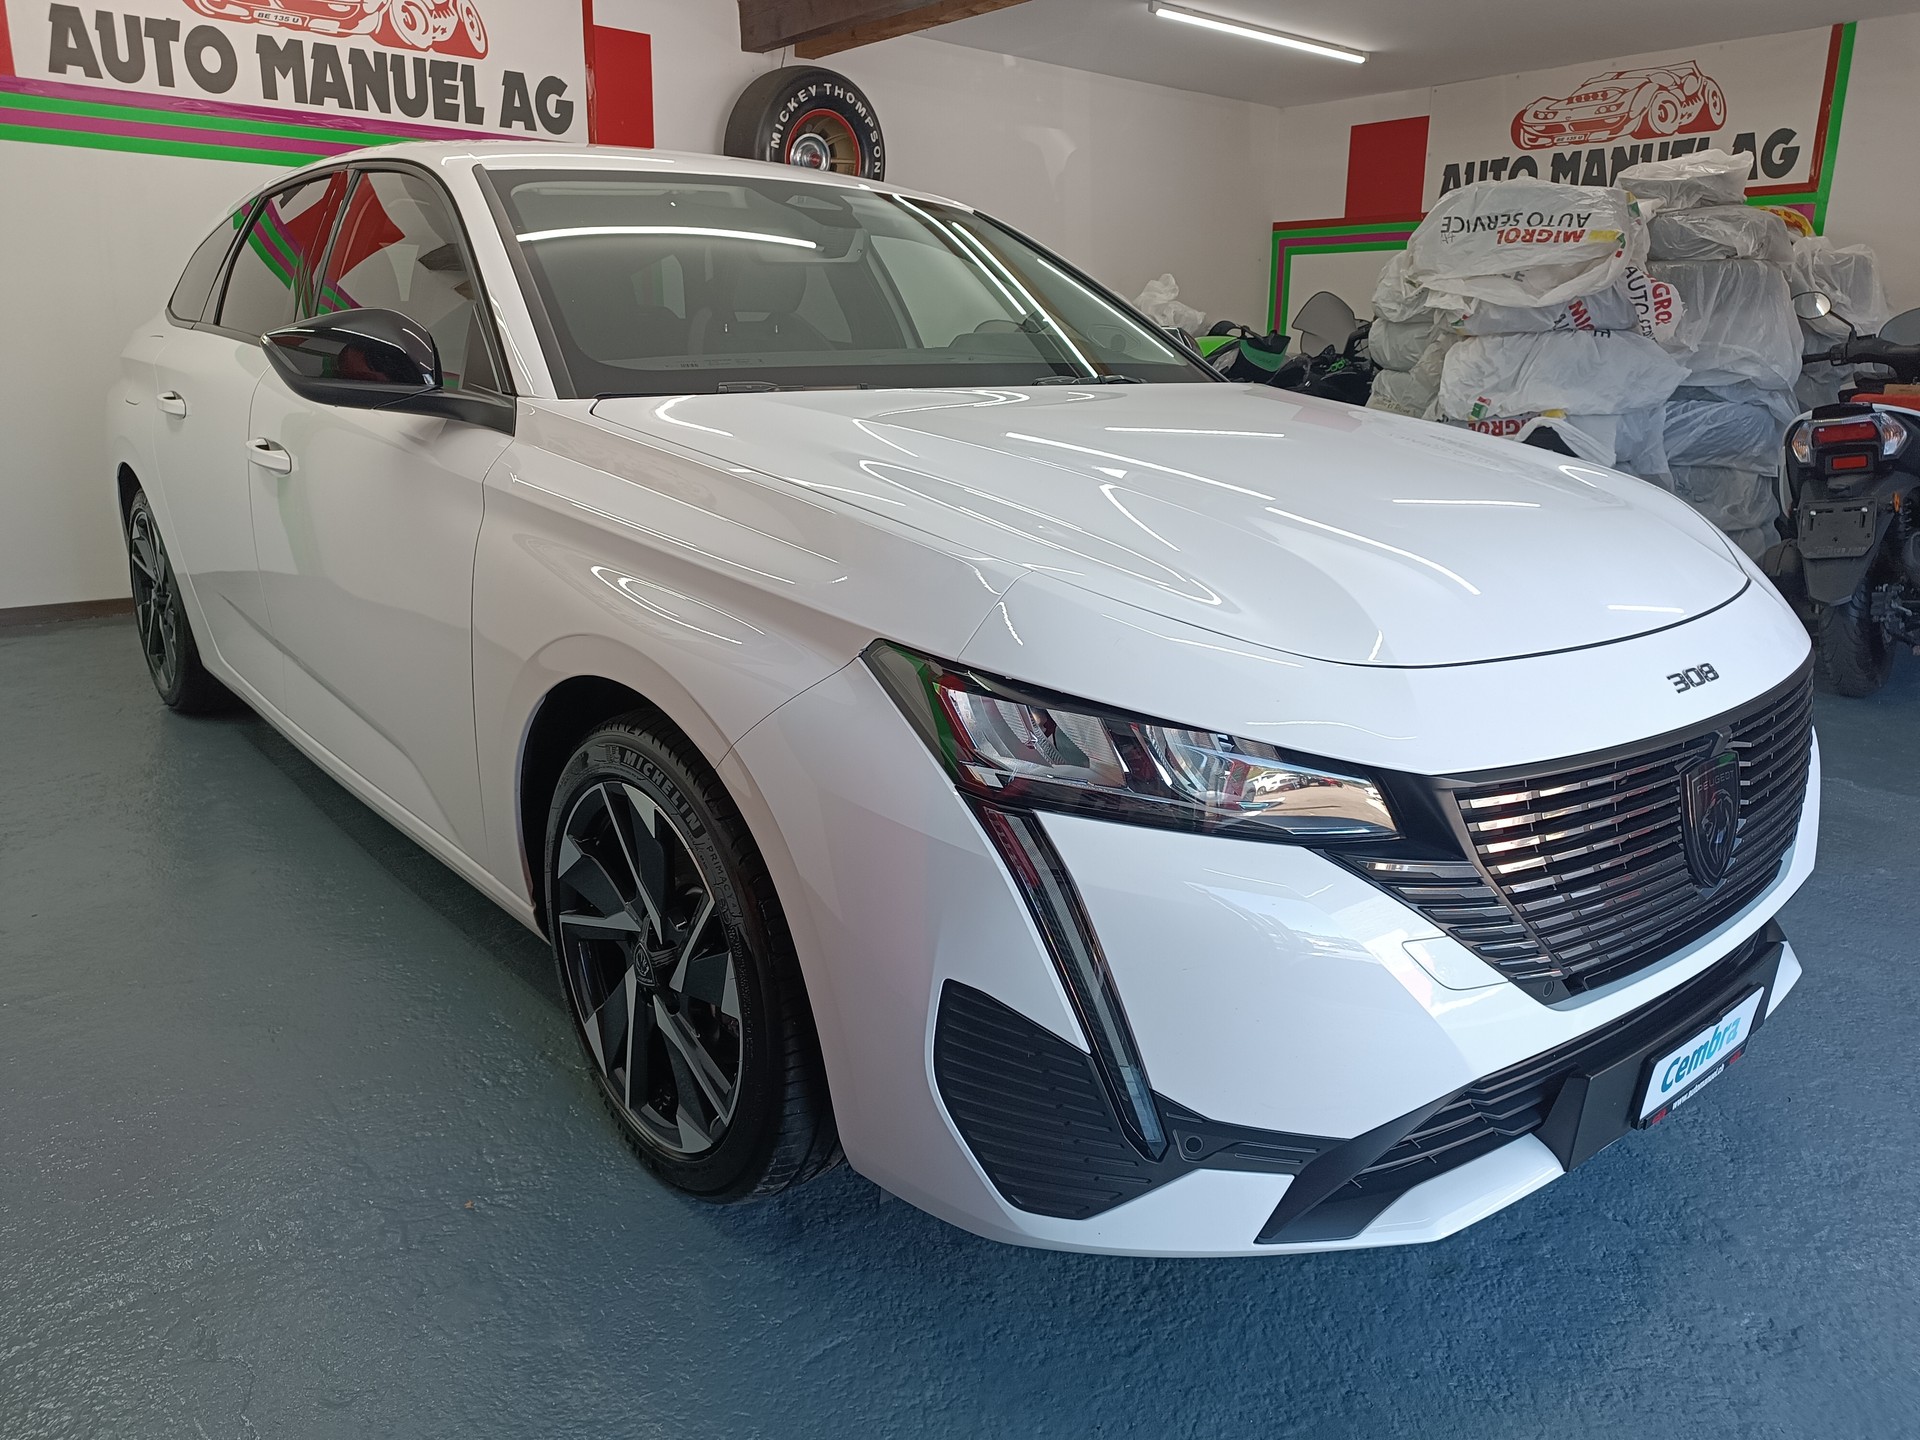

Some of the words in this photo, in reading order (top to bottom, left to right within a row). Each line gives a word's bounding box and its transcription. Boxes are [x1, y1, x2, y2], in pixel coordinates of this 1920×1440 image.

[256, 12, 271, 20] BE
[272, 14, 291, 22] 135
[291, 16, 300, 24] U
[47, 3, 238, 94] AUTO
[255, 34, 485, 124] MANUEL
[499, 71, 574, 135] AG
[770, 84, 817, 149] MICKEY
[823, 83, 881, 173] THOMPSON
[1732, 127, 1800, 181] AG
[1441, 212, 1523, 234] SERVICE
[1527, 211, 1592, 228] AUTO
[1666, 662, 1719, 693] 308
[622, 750, 701, 832] MICHELIN
[1696, 769, 1734, 794] PEUGEOT
[707, 845, 735, 900] PRIMACY
[1660, 1016, 1741, 1093] Cembra
